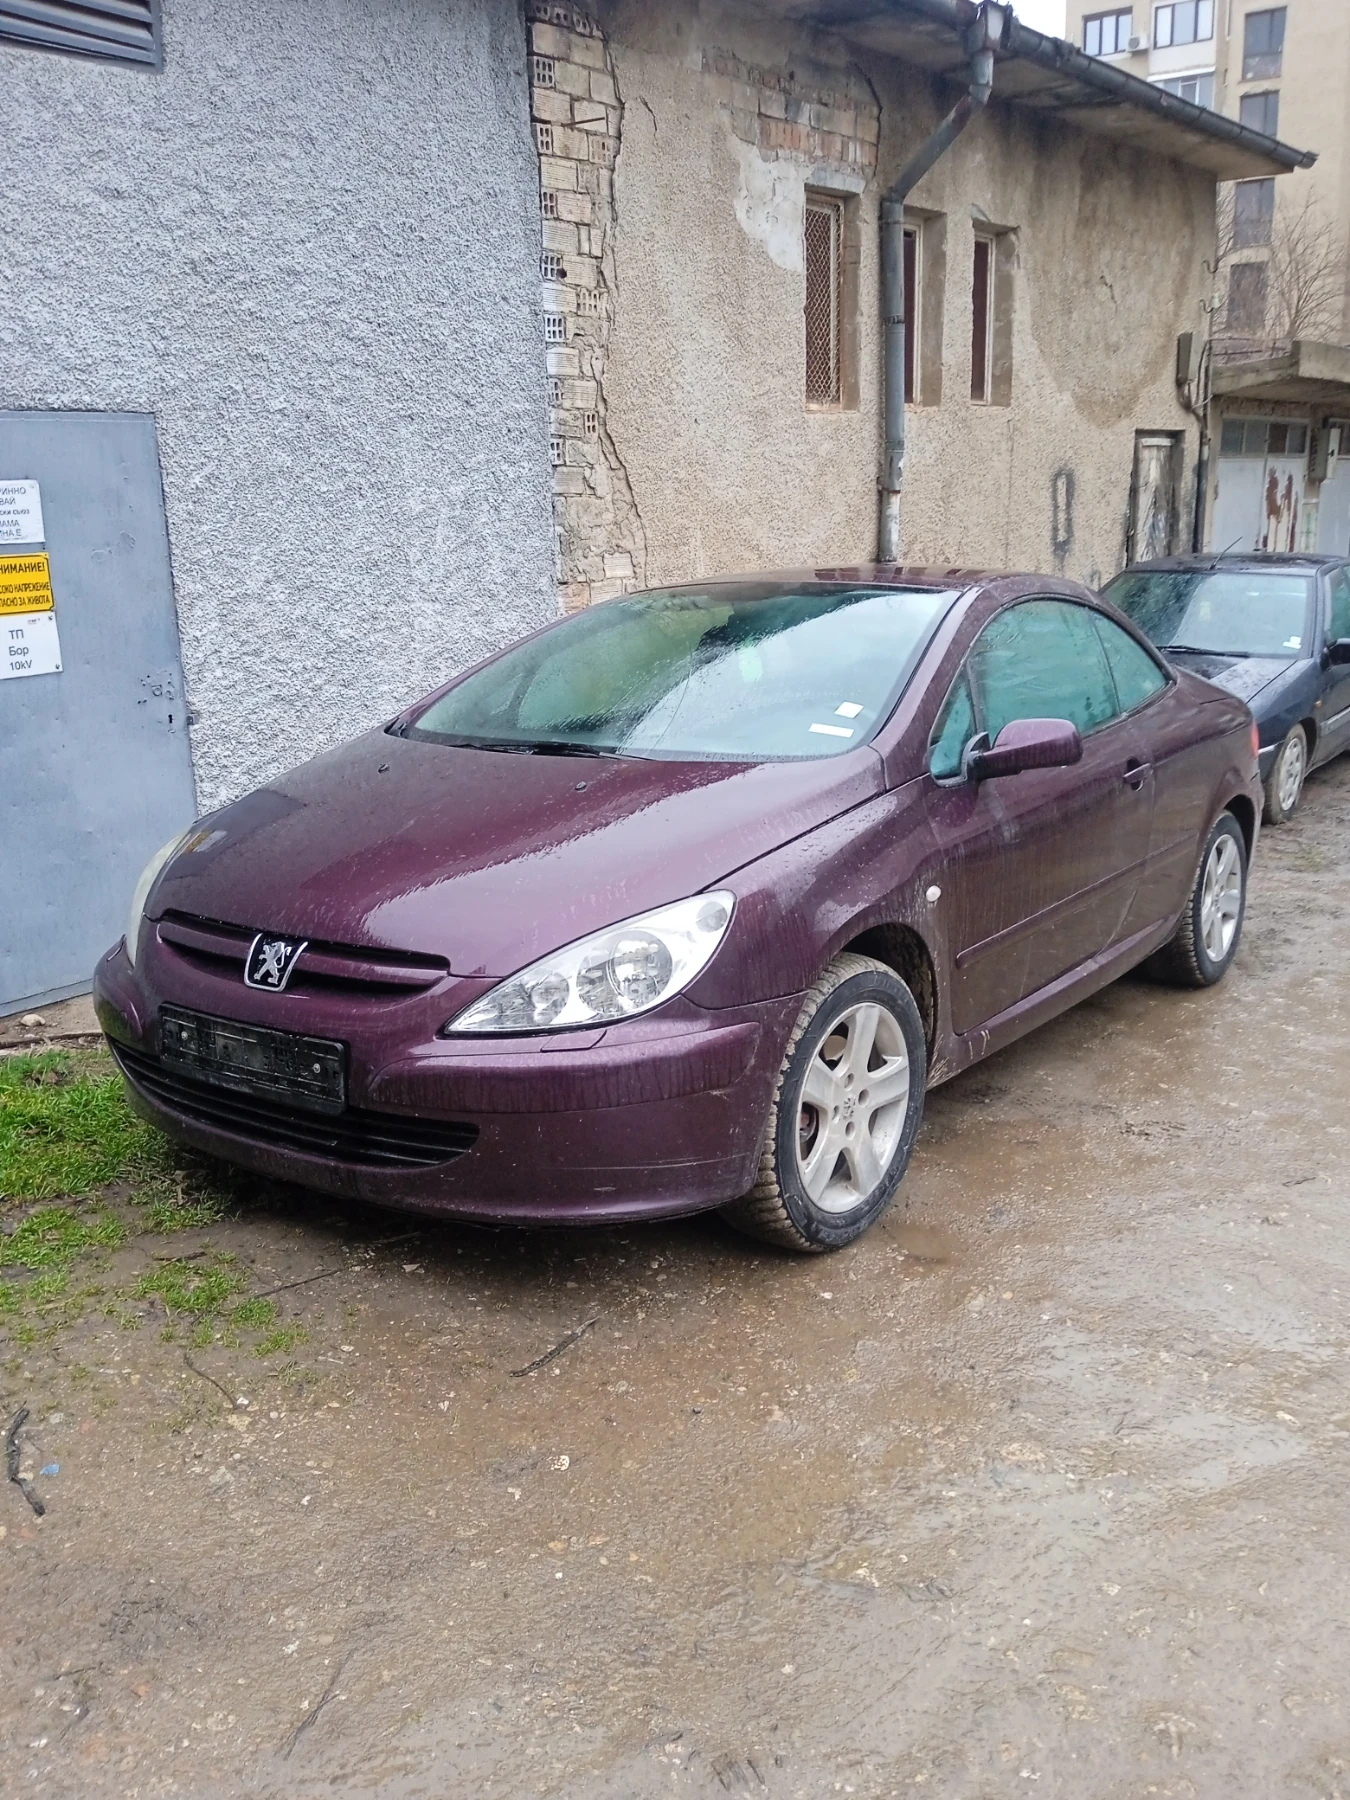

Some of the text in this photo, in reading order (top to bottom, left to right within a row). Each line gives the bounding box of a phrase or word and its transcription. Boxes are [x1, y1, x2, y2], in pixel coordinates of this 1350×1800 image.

[0, 486, 26, 495] ИННО
[0, 519, 20, 527] АМА
[8, 629, 24, 640] ТП
[9, 646, 29, 657] Бор
[10, 659, 32, 671] 10kV
